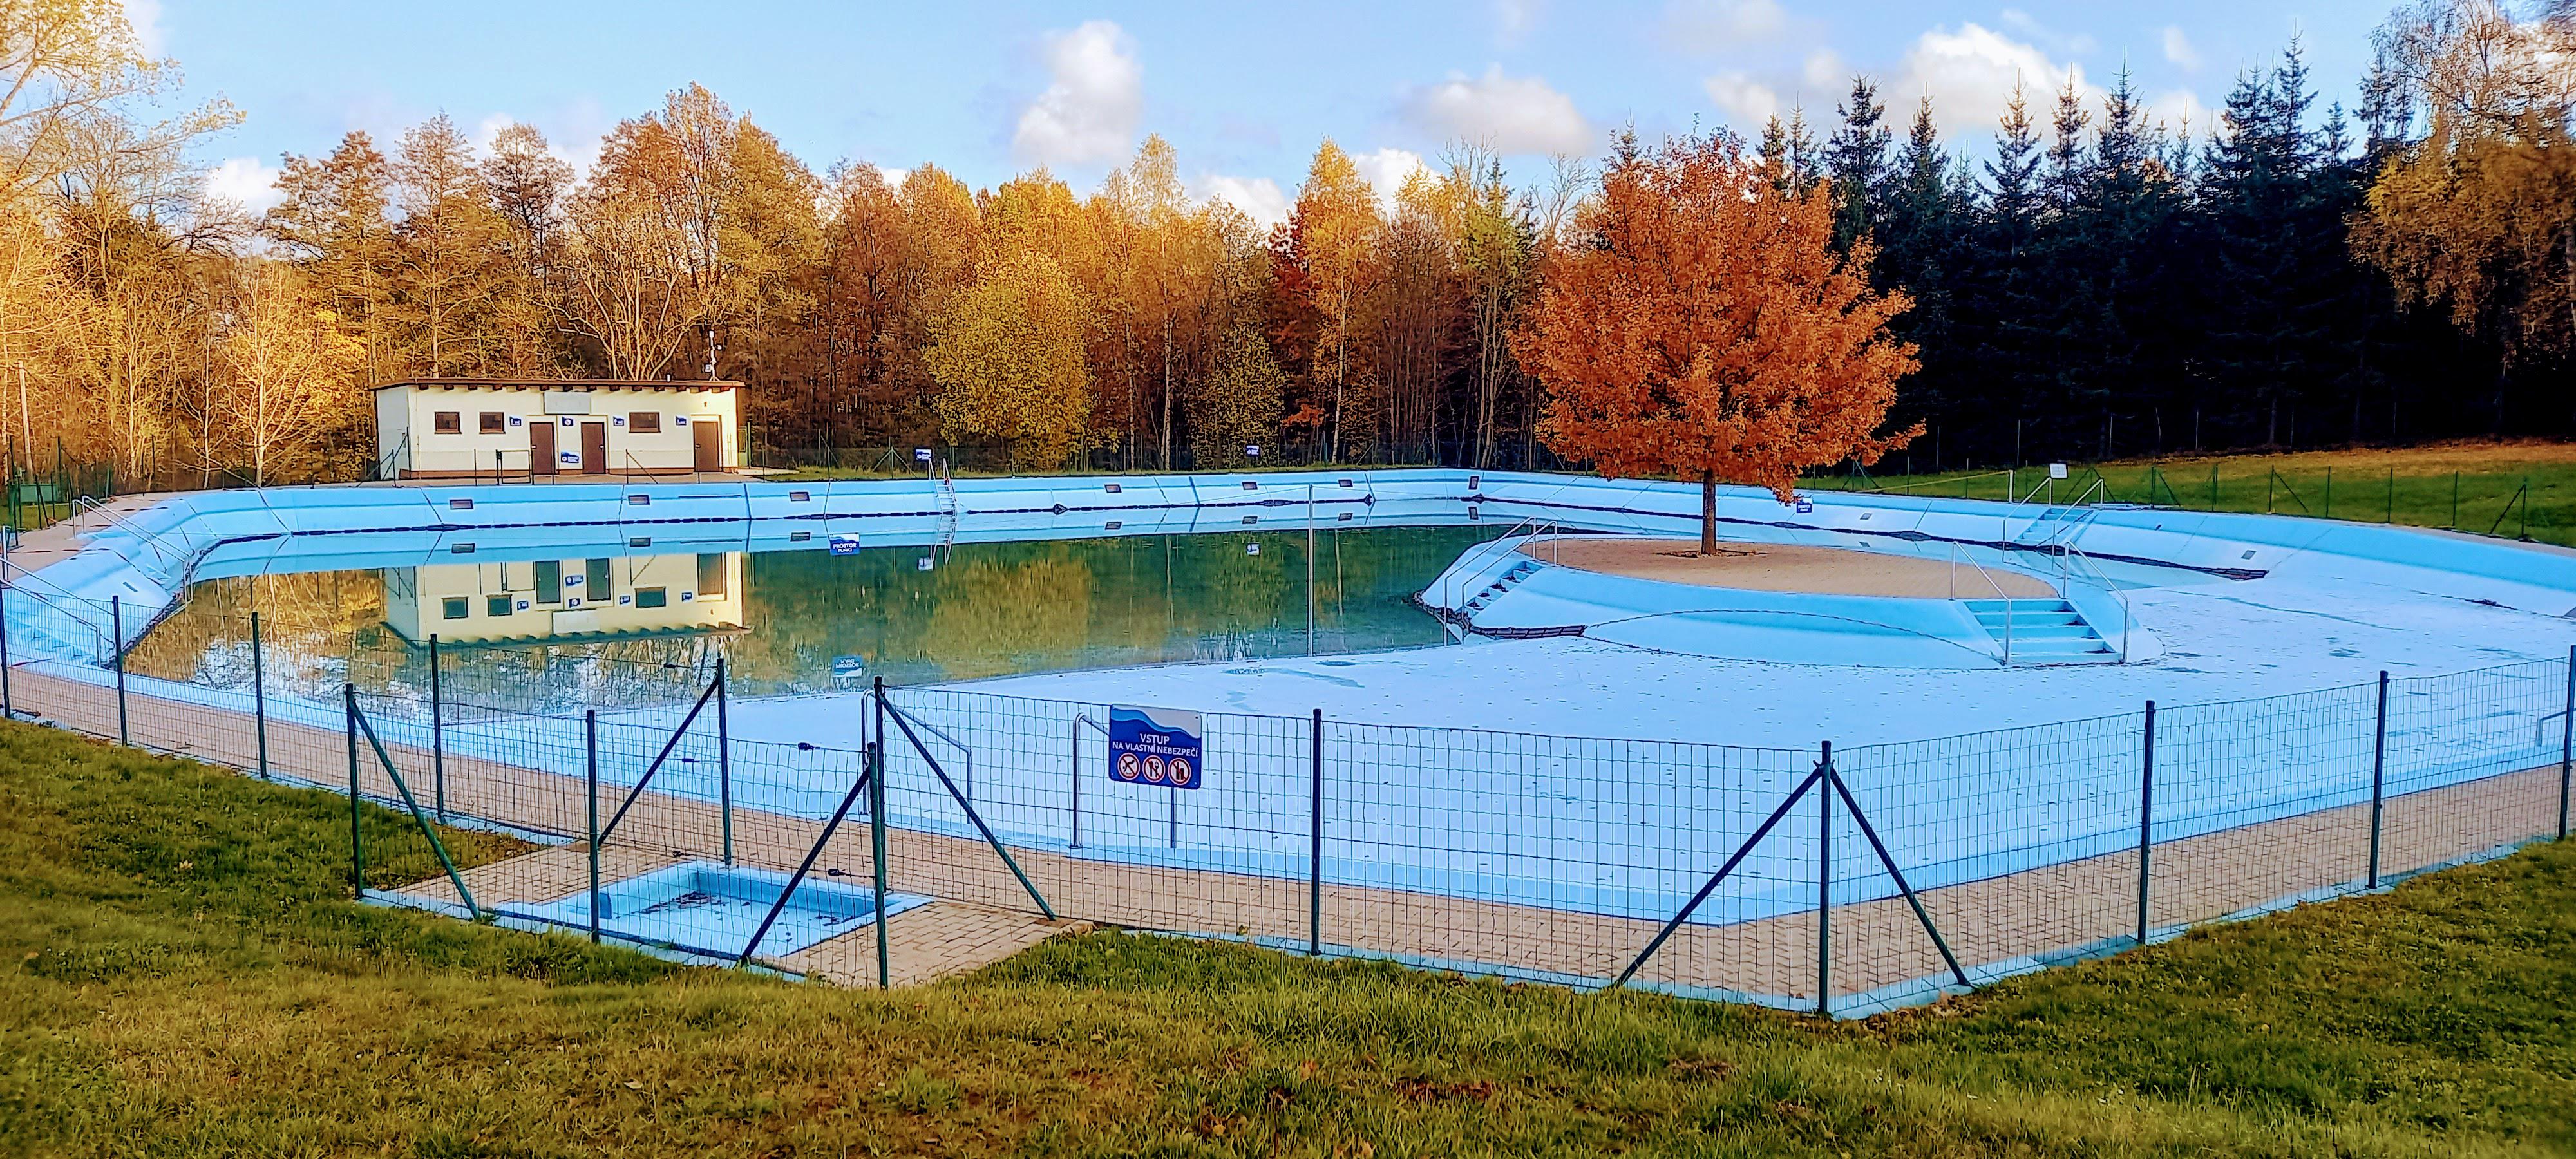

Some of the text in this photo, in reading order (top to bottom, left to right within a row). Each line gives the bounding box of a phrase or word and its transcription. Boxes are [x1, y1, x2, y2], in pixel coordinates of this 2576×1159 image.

[1139, 733, 1170, 745] VSTUP
[1112, 741, 1198, 757] NA VLASTNÍ NEBEZPEČÍ
